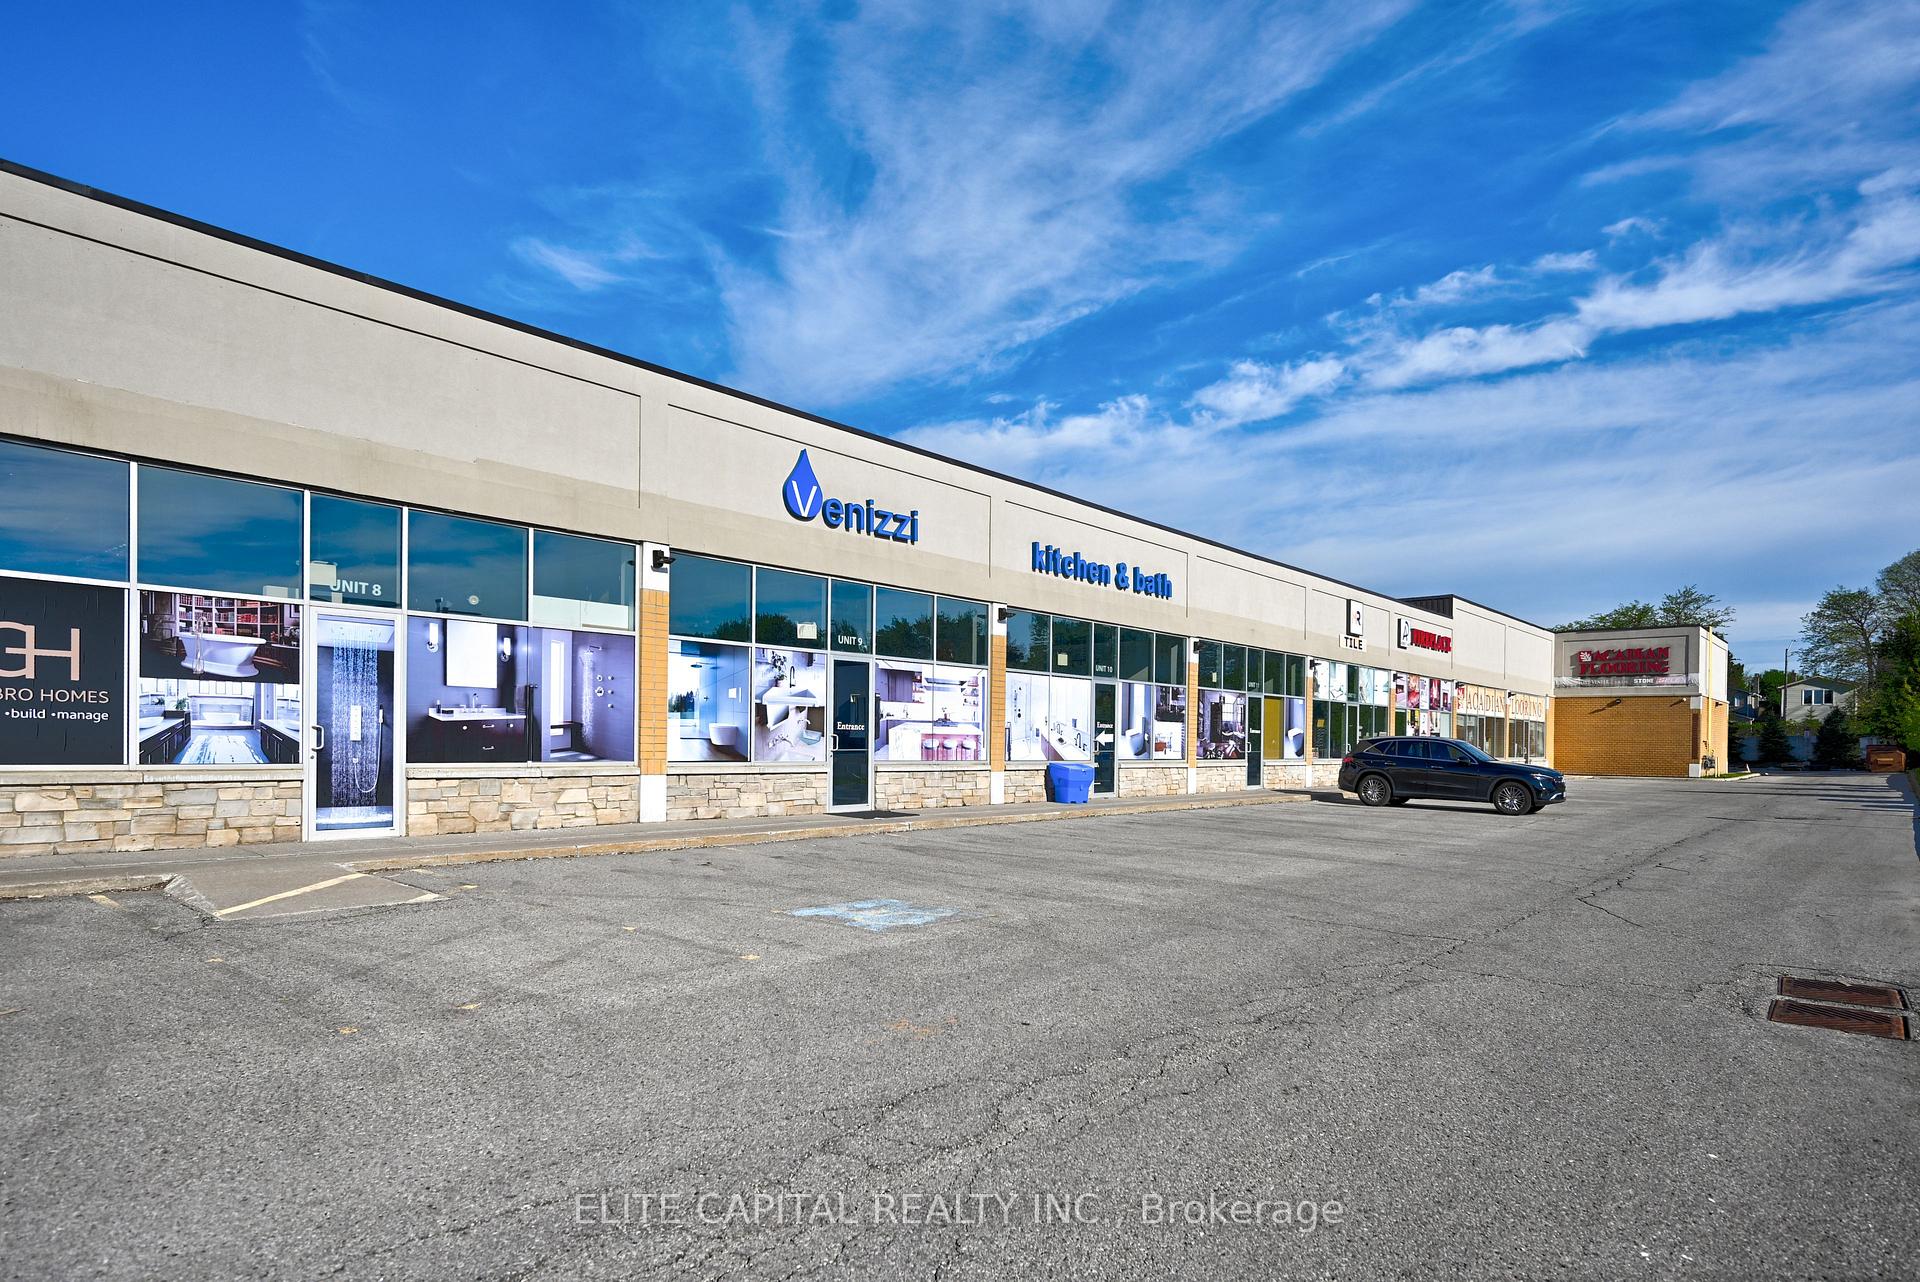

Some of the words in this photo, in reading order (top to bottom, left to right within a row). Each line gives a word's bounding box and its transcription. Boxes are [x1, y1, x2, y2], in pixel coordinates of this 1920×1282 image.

[792, 480, 918, 545] Venizzi
[1031, 541, 1111, 587] kitchen
[1114, 562, 1130, 591] &
[1132, 566, 1172, 600] bath
[329, 579, 369, 595] UNIT
[371, 584, 382, 596] 8
[837, 635, 857, 646] UNIT
[857, 637, 863, 646] 9
[1344, 636, 1363, 651] TILE
[1593, 646, 1671, 661] ACADIAN
[1578, 660, 1670, 676] FLOORING
[40, 688, 110, 704] HOMES
[1466, 691, 1506, 713] ACADIAN
[836, 721, 865, 731] Entrance
